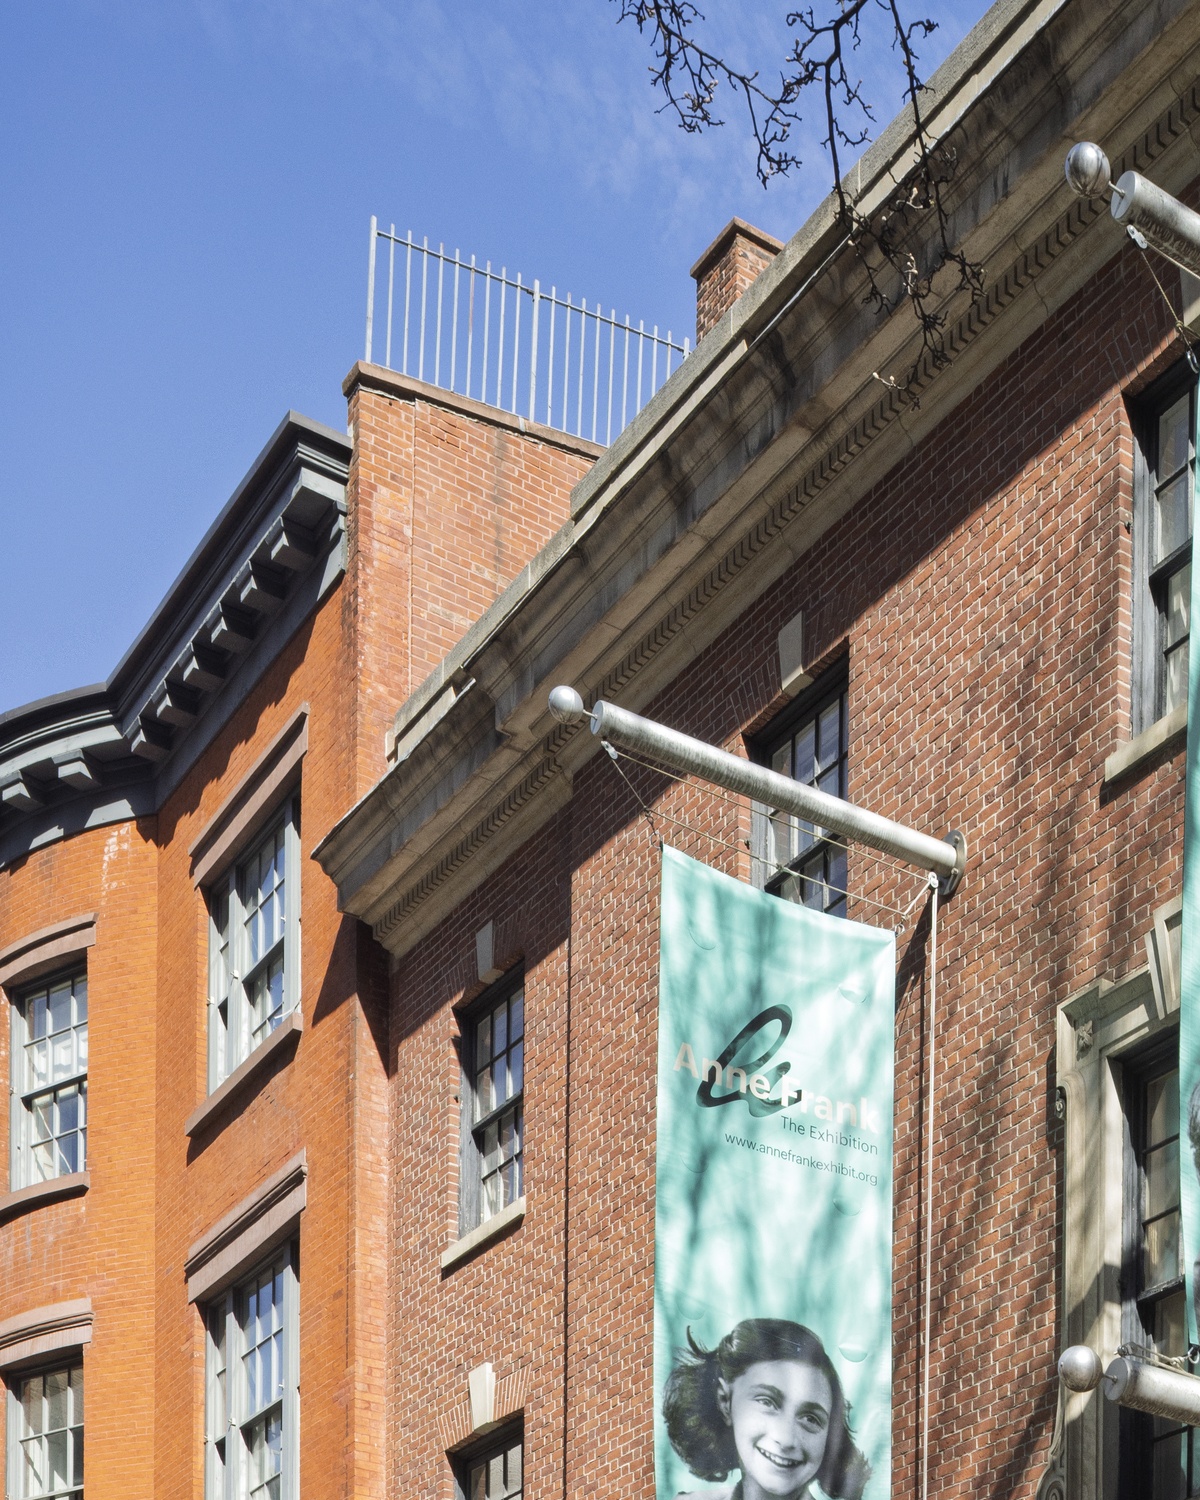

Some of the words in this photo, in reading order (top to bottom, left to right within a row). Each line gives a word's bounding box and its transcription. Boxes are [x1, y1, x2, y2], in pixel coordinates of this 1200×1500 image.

[672, 1041, 771, 1100] Anne
[780, 1074, 879, 1134] Frank
[725, 1132, 878, 1187] www.annefrankexhibit.org
[781, 1115, 806, 1135] The
[810, 1126, 878, 1155] Exhibition
